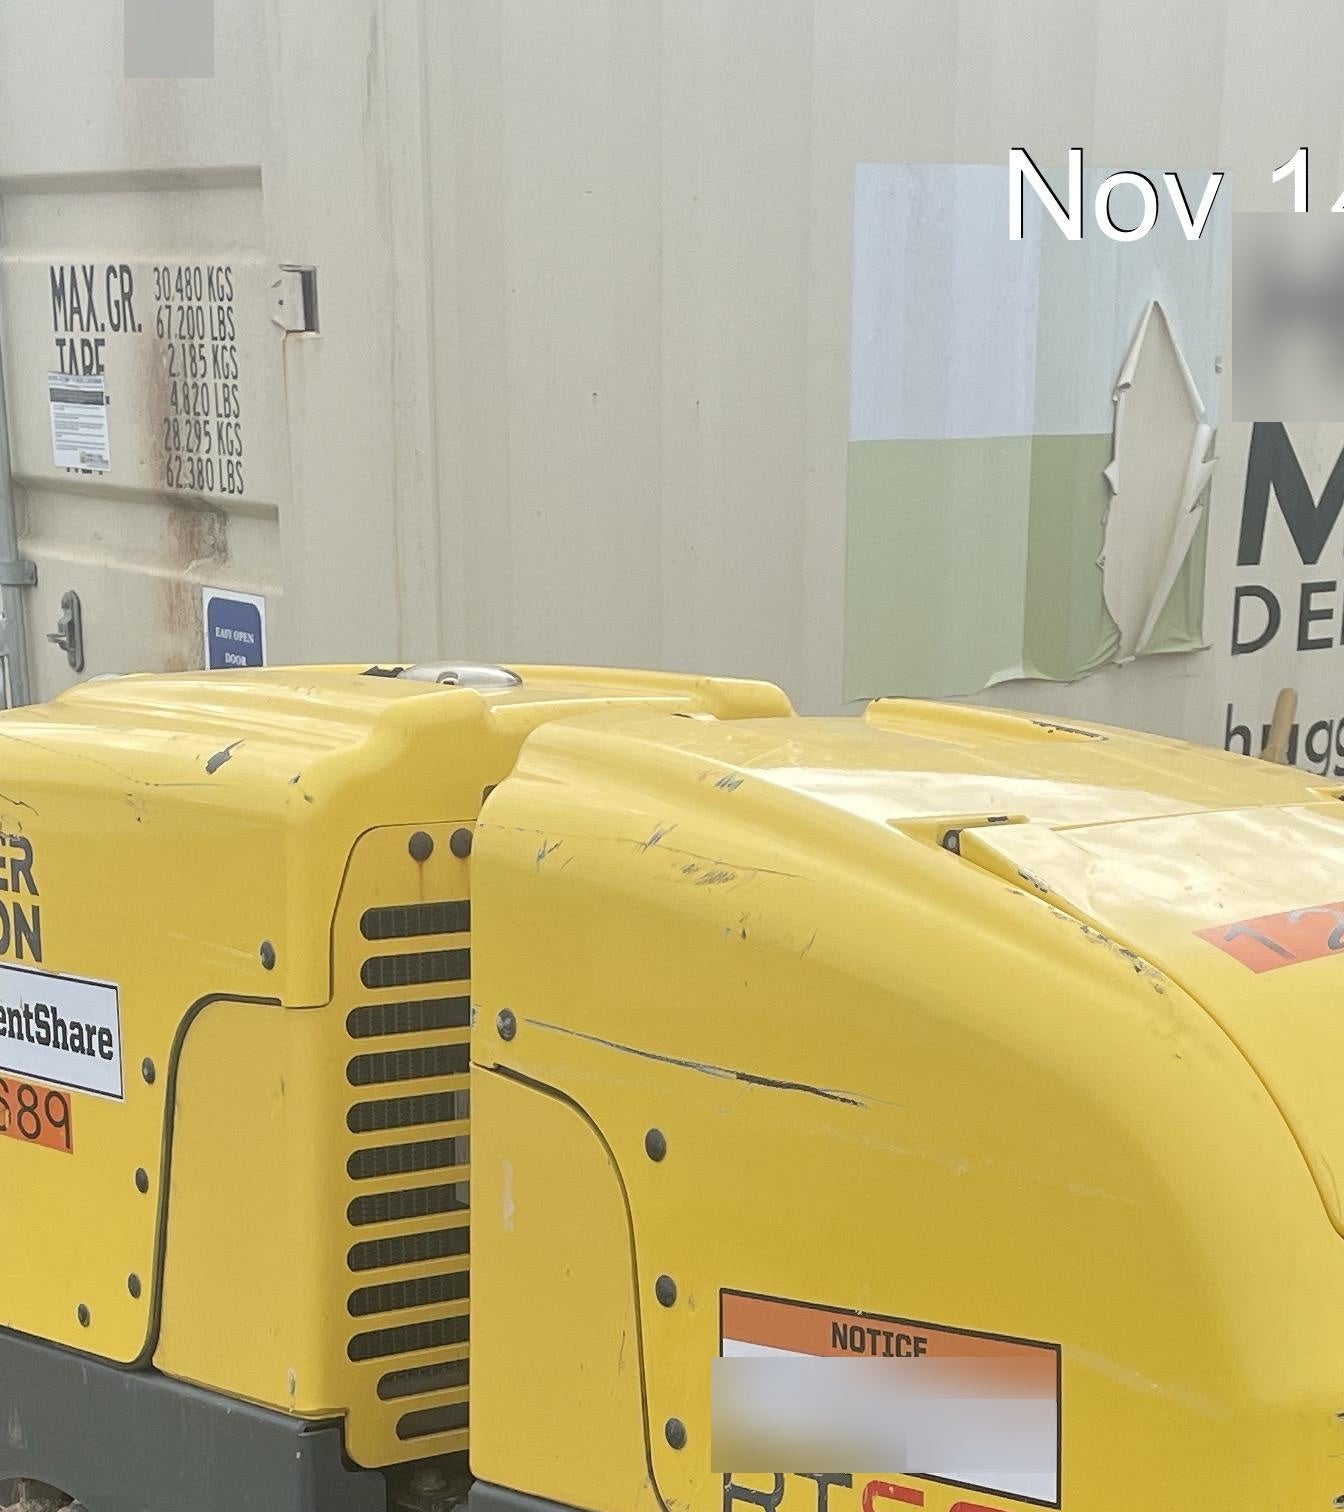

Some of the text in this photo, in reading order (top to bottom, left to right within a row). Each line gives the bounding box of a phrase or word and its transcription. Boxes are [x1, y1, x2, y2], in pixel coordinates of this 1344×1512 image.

[152, 266, 203, 302] 30.480
[207, 265, 234, 303] KGS
[156, 305, 236, 342] 67.200 LBS
[167, 343, 207, 379] 2.185
[212, 343, 239, 380] KGS
[170, 381, 241, 419] 4.820 LBS
[163, 417, 243, 458] 28.295 KGS
[165, 455, 244, 495] 62.380 LBS
[233, 630, 255, 644] OPEN
[224, 652, 247, 667] DOOR
[831, 1320, 929, 1358] NOTICE
